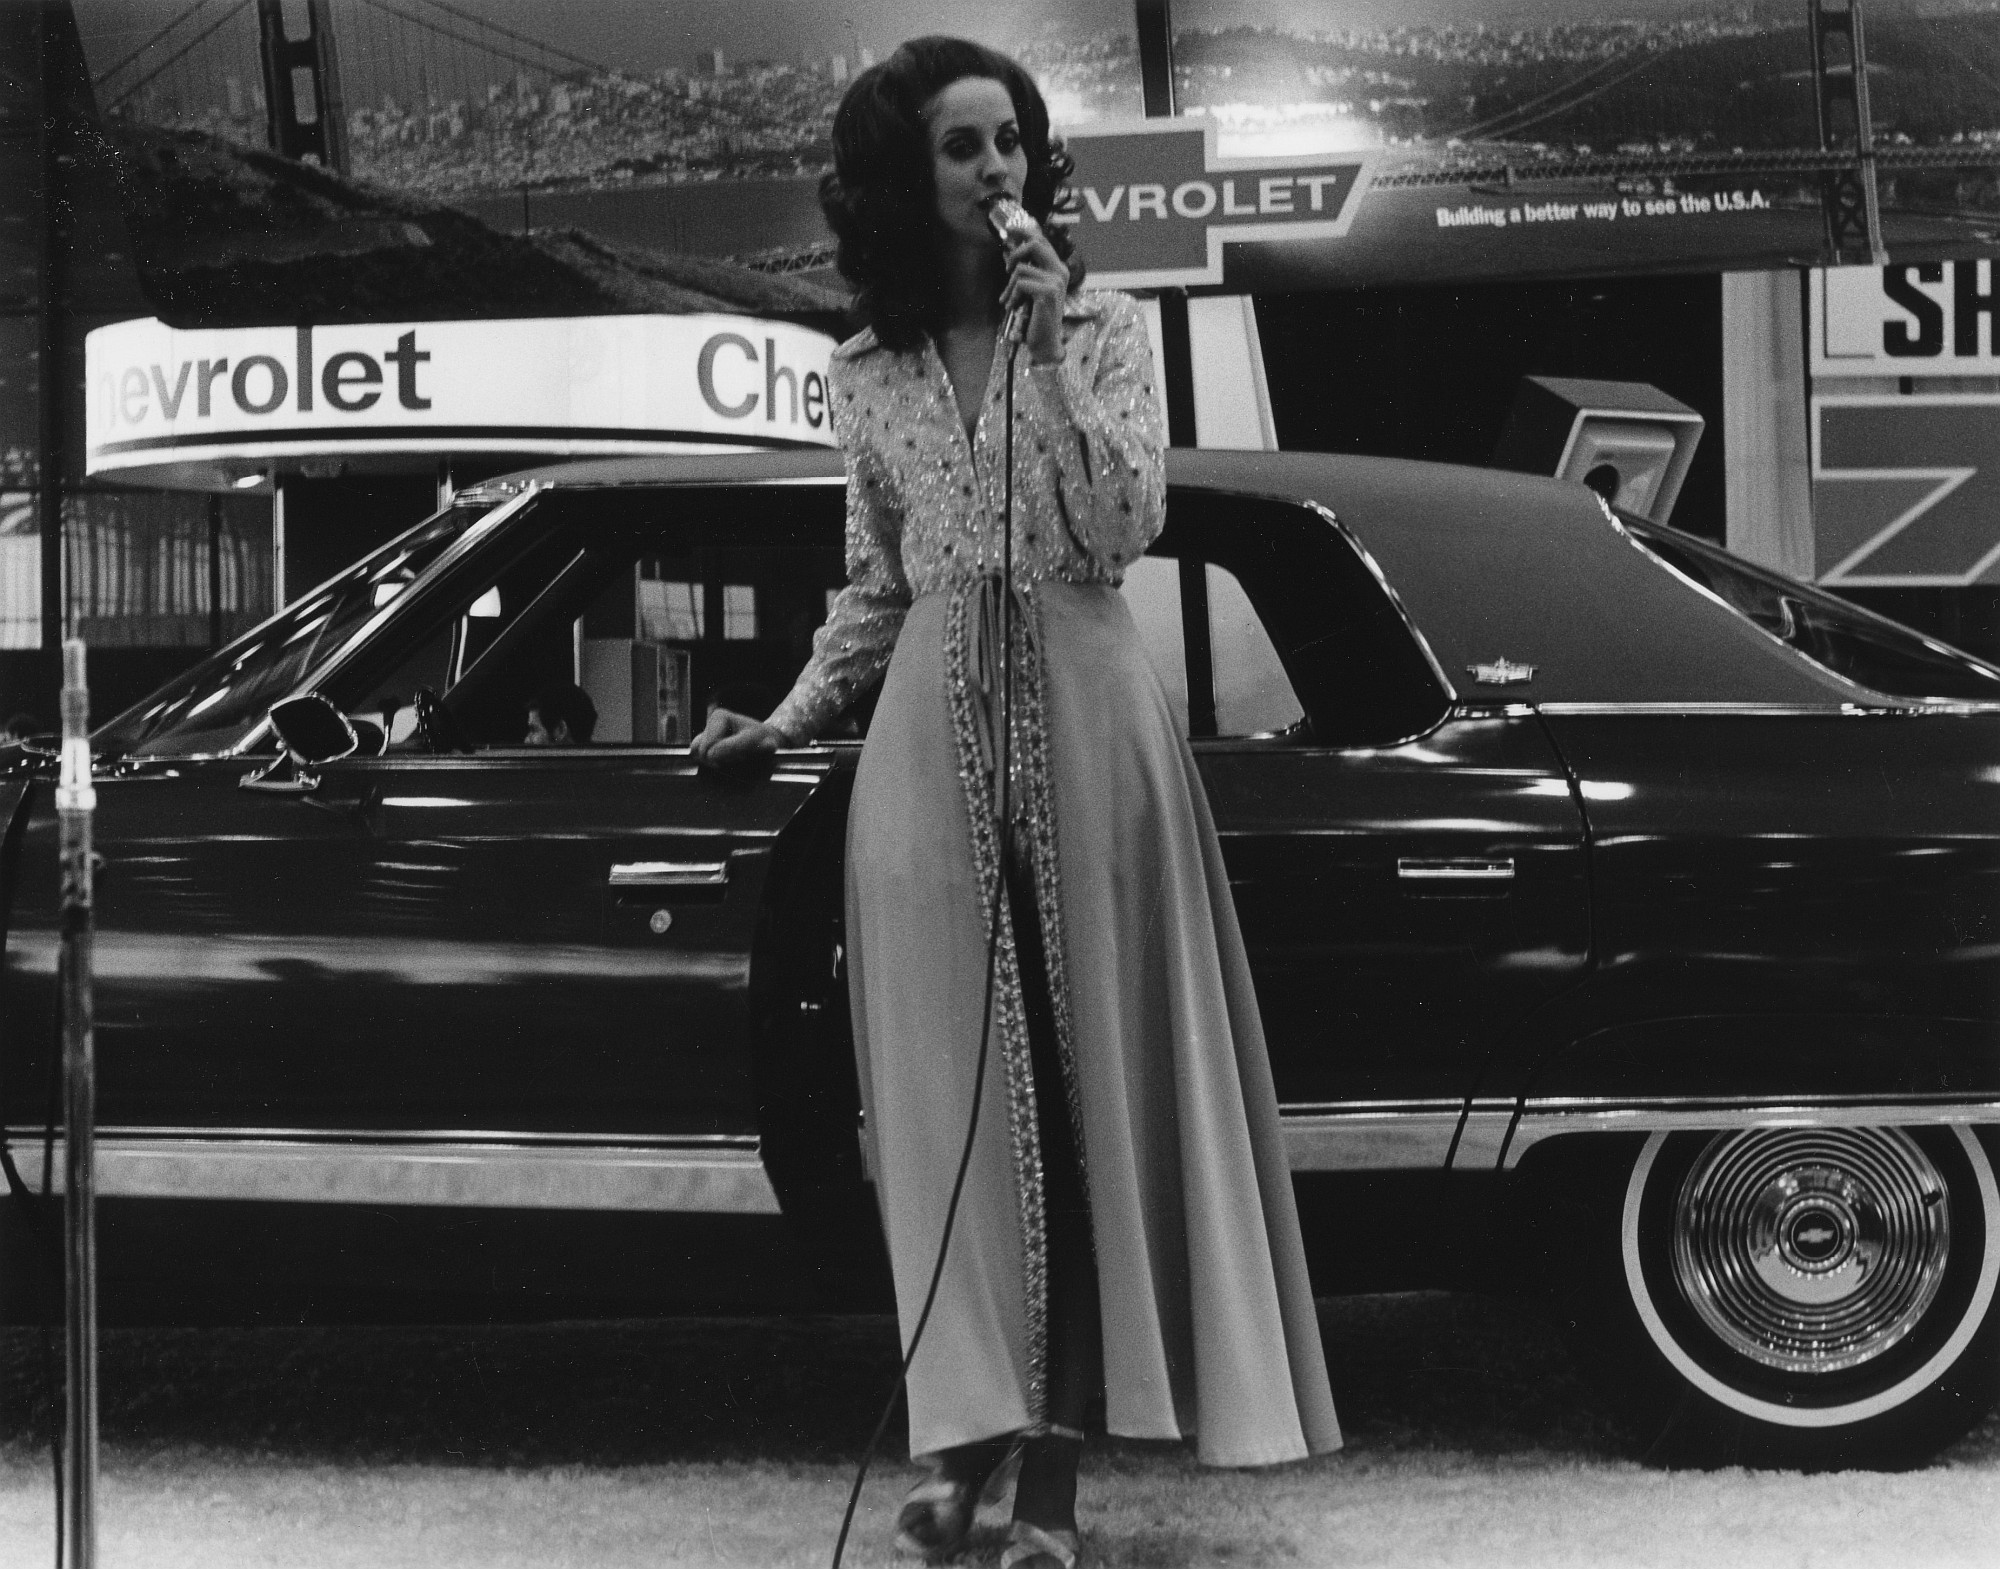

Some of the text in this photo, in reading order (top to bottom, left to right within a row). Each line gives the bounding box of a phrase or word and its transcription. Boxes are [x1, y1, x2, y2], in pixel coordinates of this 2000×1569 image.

[1436, 188, 1771, 227] Building a better way to see the U.S.A.
